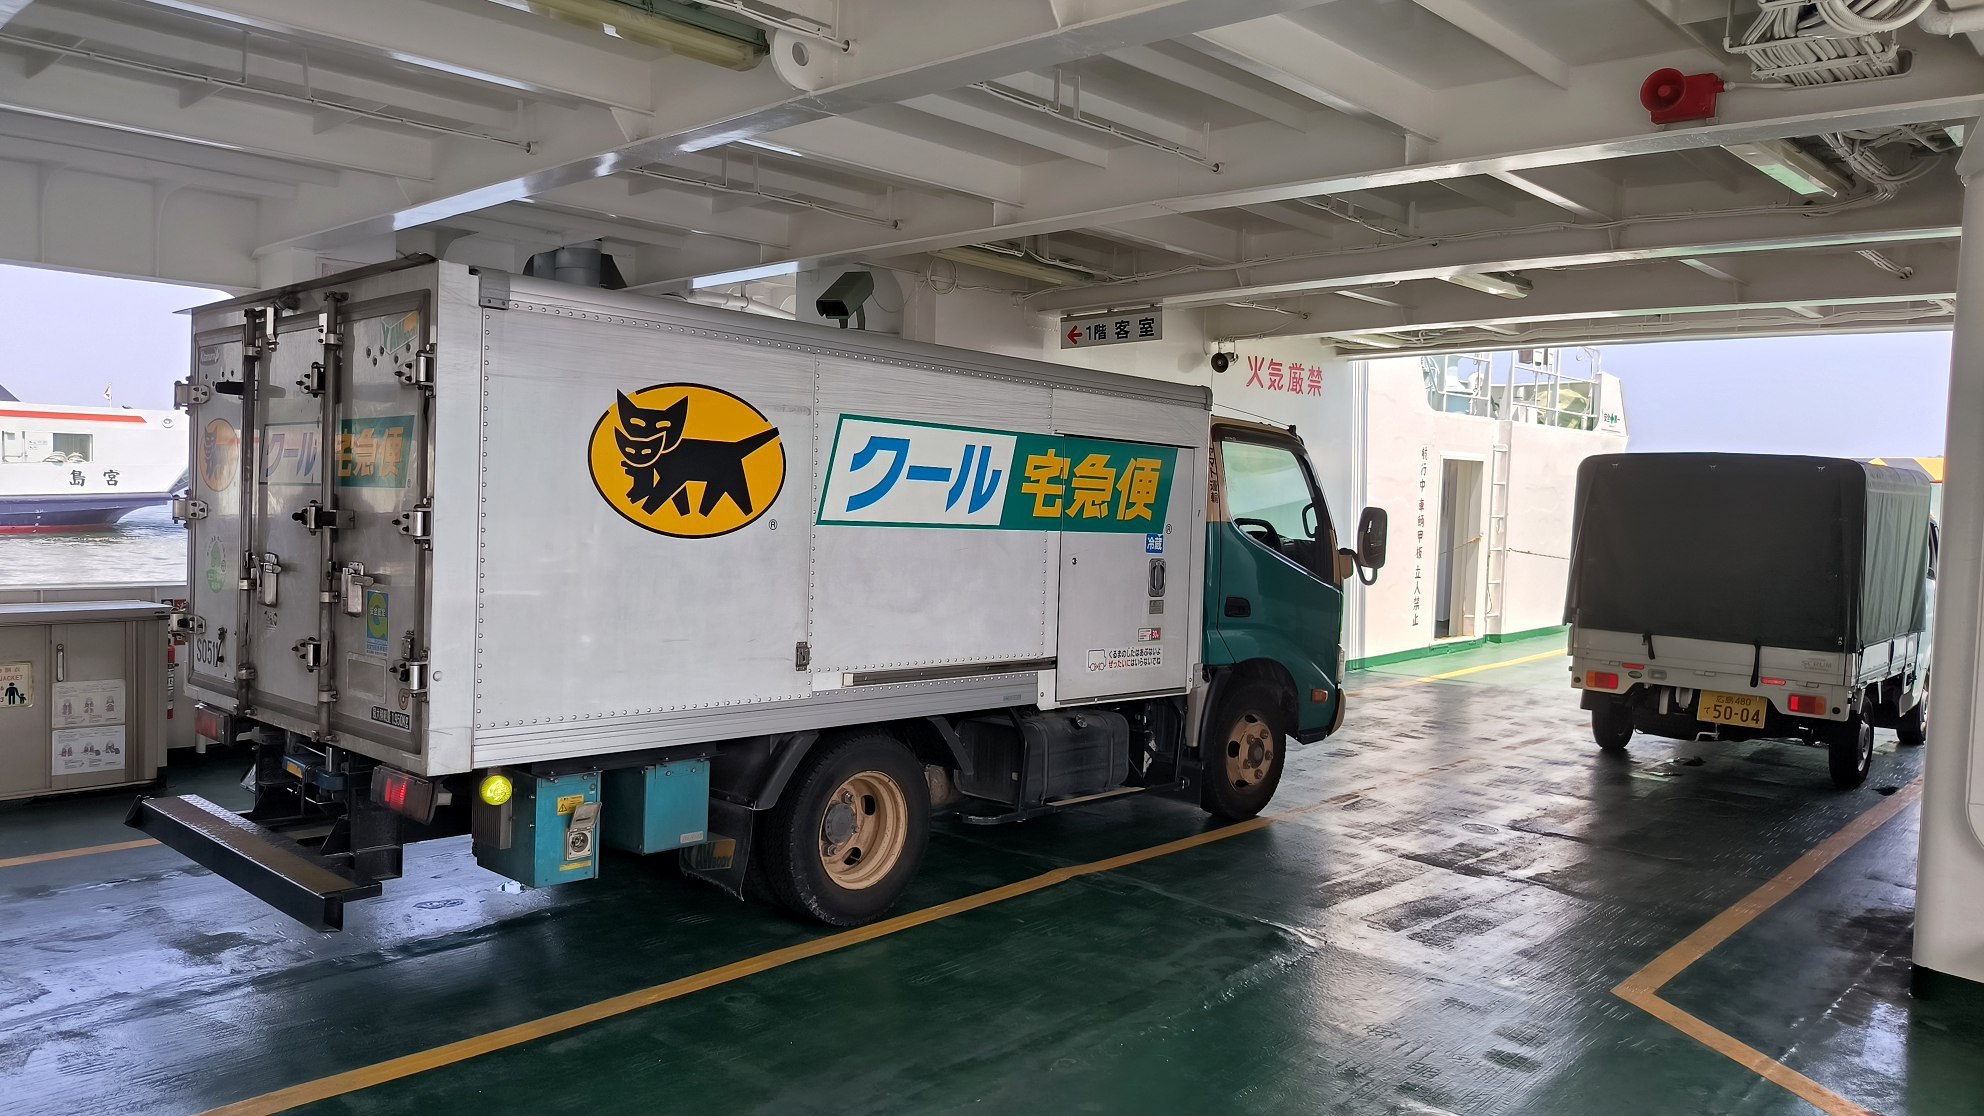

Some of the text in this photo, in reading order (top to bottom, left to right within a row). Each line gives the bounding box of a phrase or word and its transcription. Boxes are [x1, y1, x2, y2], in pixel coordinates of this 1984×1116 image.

[1245, 355, 1323, 397] 火気厳禁
[336, 427, 404, 477] 宅急便
[846, 435, 1162, 521] クール 宅急便
[1146, 536, 1163, 551] 冷蔵
[1801, 660, 1832, 669] SCRUM
[1713, 704, 1760, 725] 50-04
